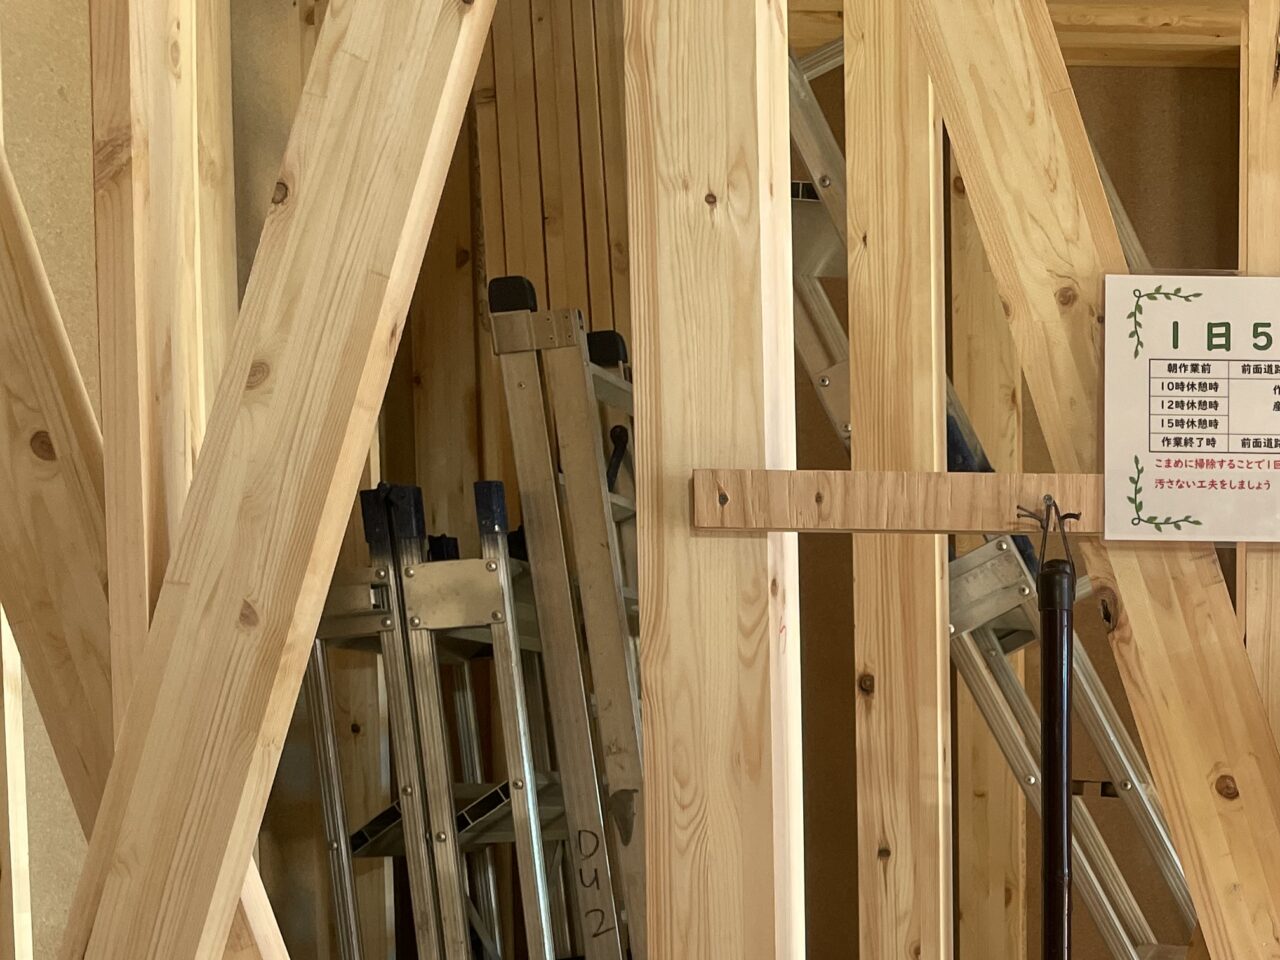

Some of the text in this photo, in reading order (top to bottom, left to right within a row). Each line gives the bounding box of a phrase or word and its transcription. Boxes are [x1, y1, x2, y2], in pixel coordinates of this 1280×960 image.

[1167, 363, 1212, 375] 朝作業前
[1161, 381, 1219, 393] 10時休憩時
[1161, 400, 1219, 411] 12時休憩時
[1161, 418, 1219, 429] 15時休憩時
[1161, 437, 1217, 448] 作業終了時
[1154, 479, 1271, 490] 汚さない工夫をしましょう
